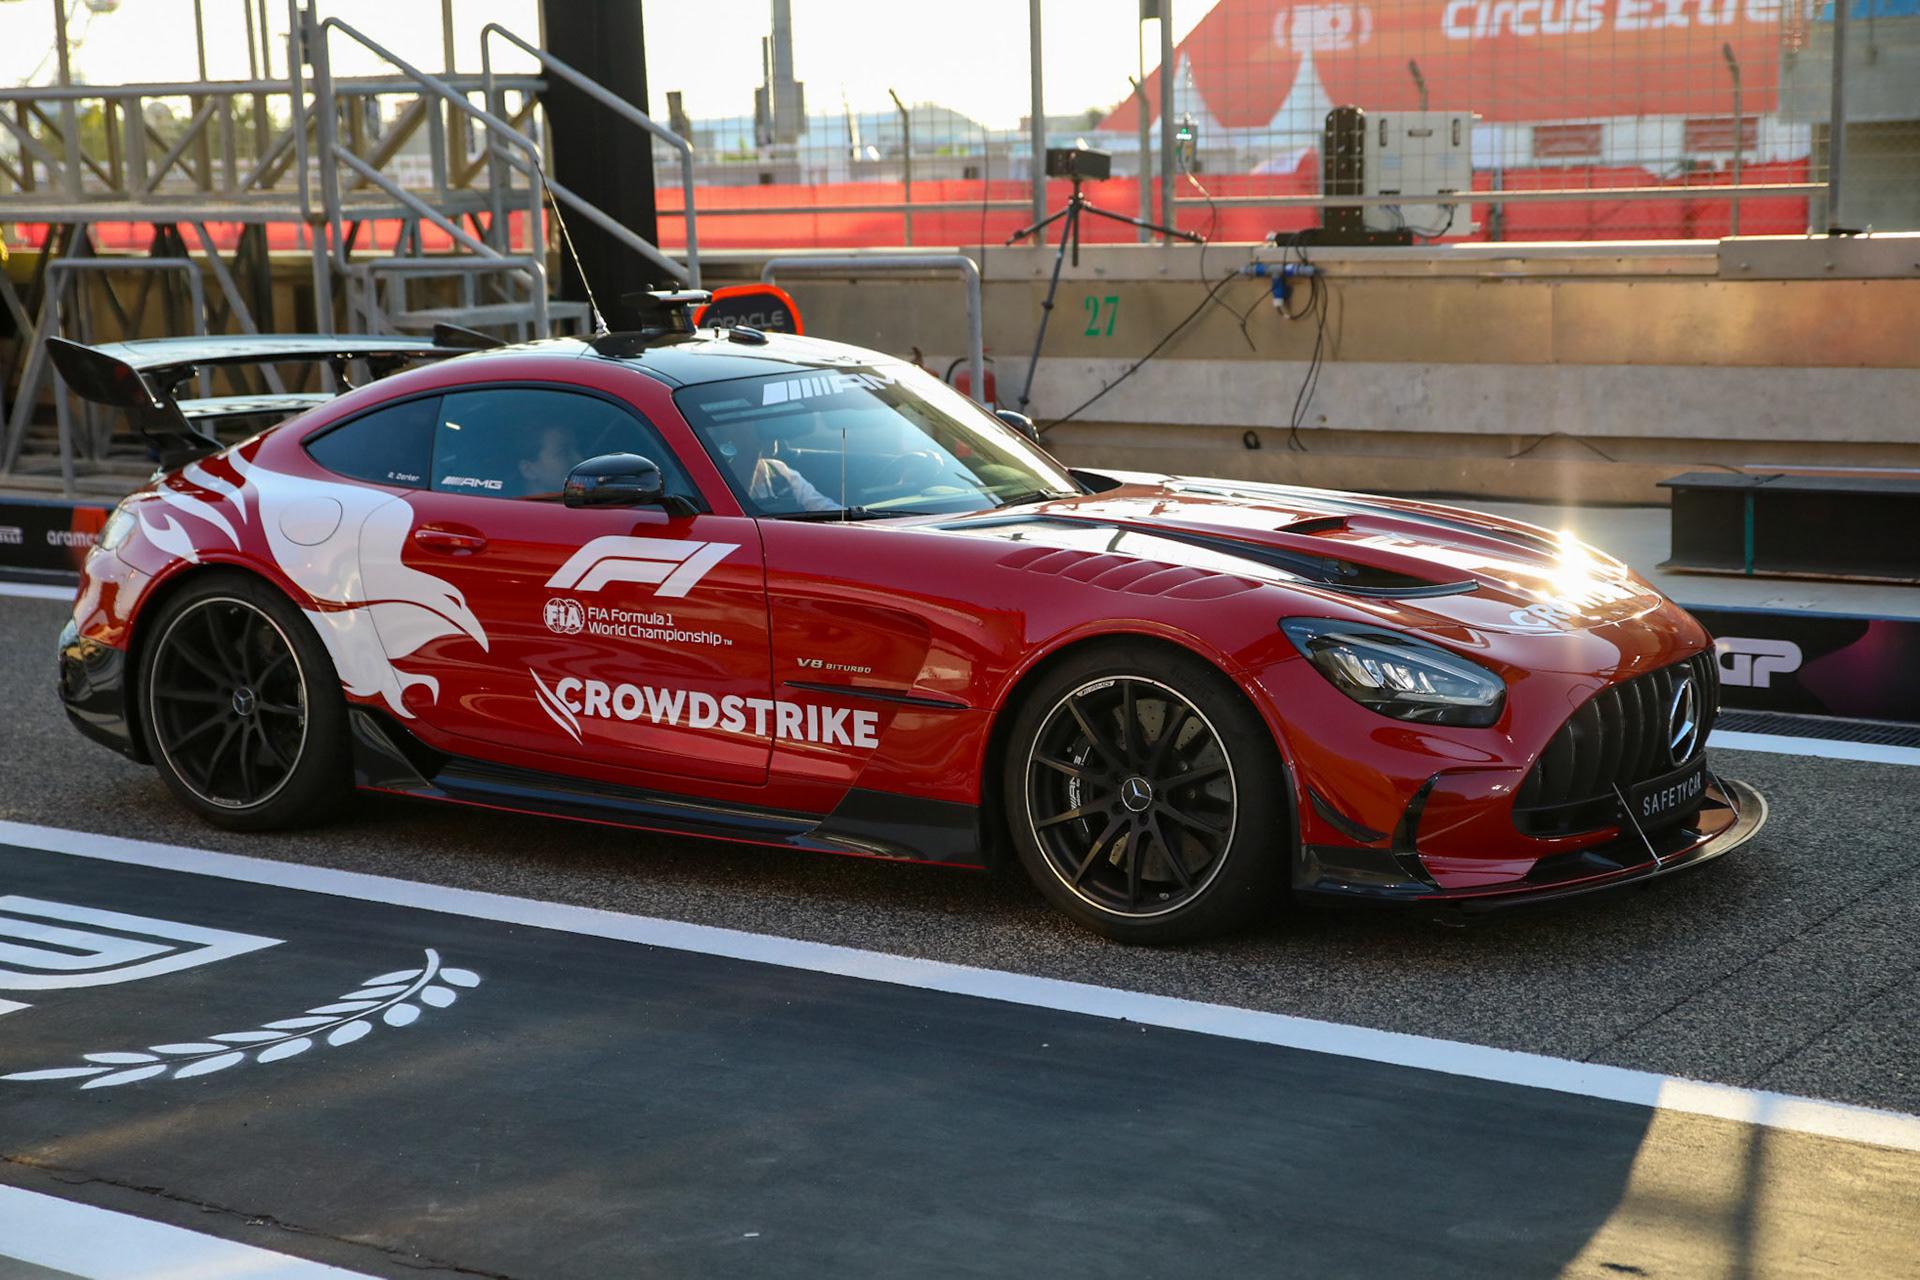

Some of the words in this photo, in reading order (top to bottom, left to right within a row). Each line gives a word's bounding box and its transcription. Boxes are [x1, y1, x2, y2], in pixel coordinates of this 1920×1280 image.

[706, 310, 784, 328] ORACLE
[1084, 295, 1119, 337] 27
[544, 535, 741, 597] F1
[588, 607, 609, 620] FIA
[611, 609, 665, 625] Formula
[665, 613, 674, 626] 1
[588, 621, 627, 637] World
[628, 625, 723, 646] Championship
[796, 657, 824, 669] V8
[826, 663, 872, 674] BITURBO
[555, 676, 880, 749] CROWDSTRIKE
